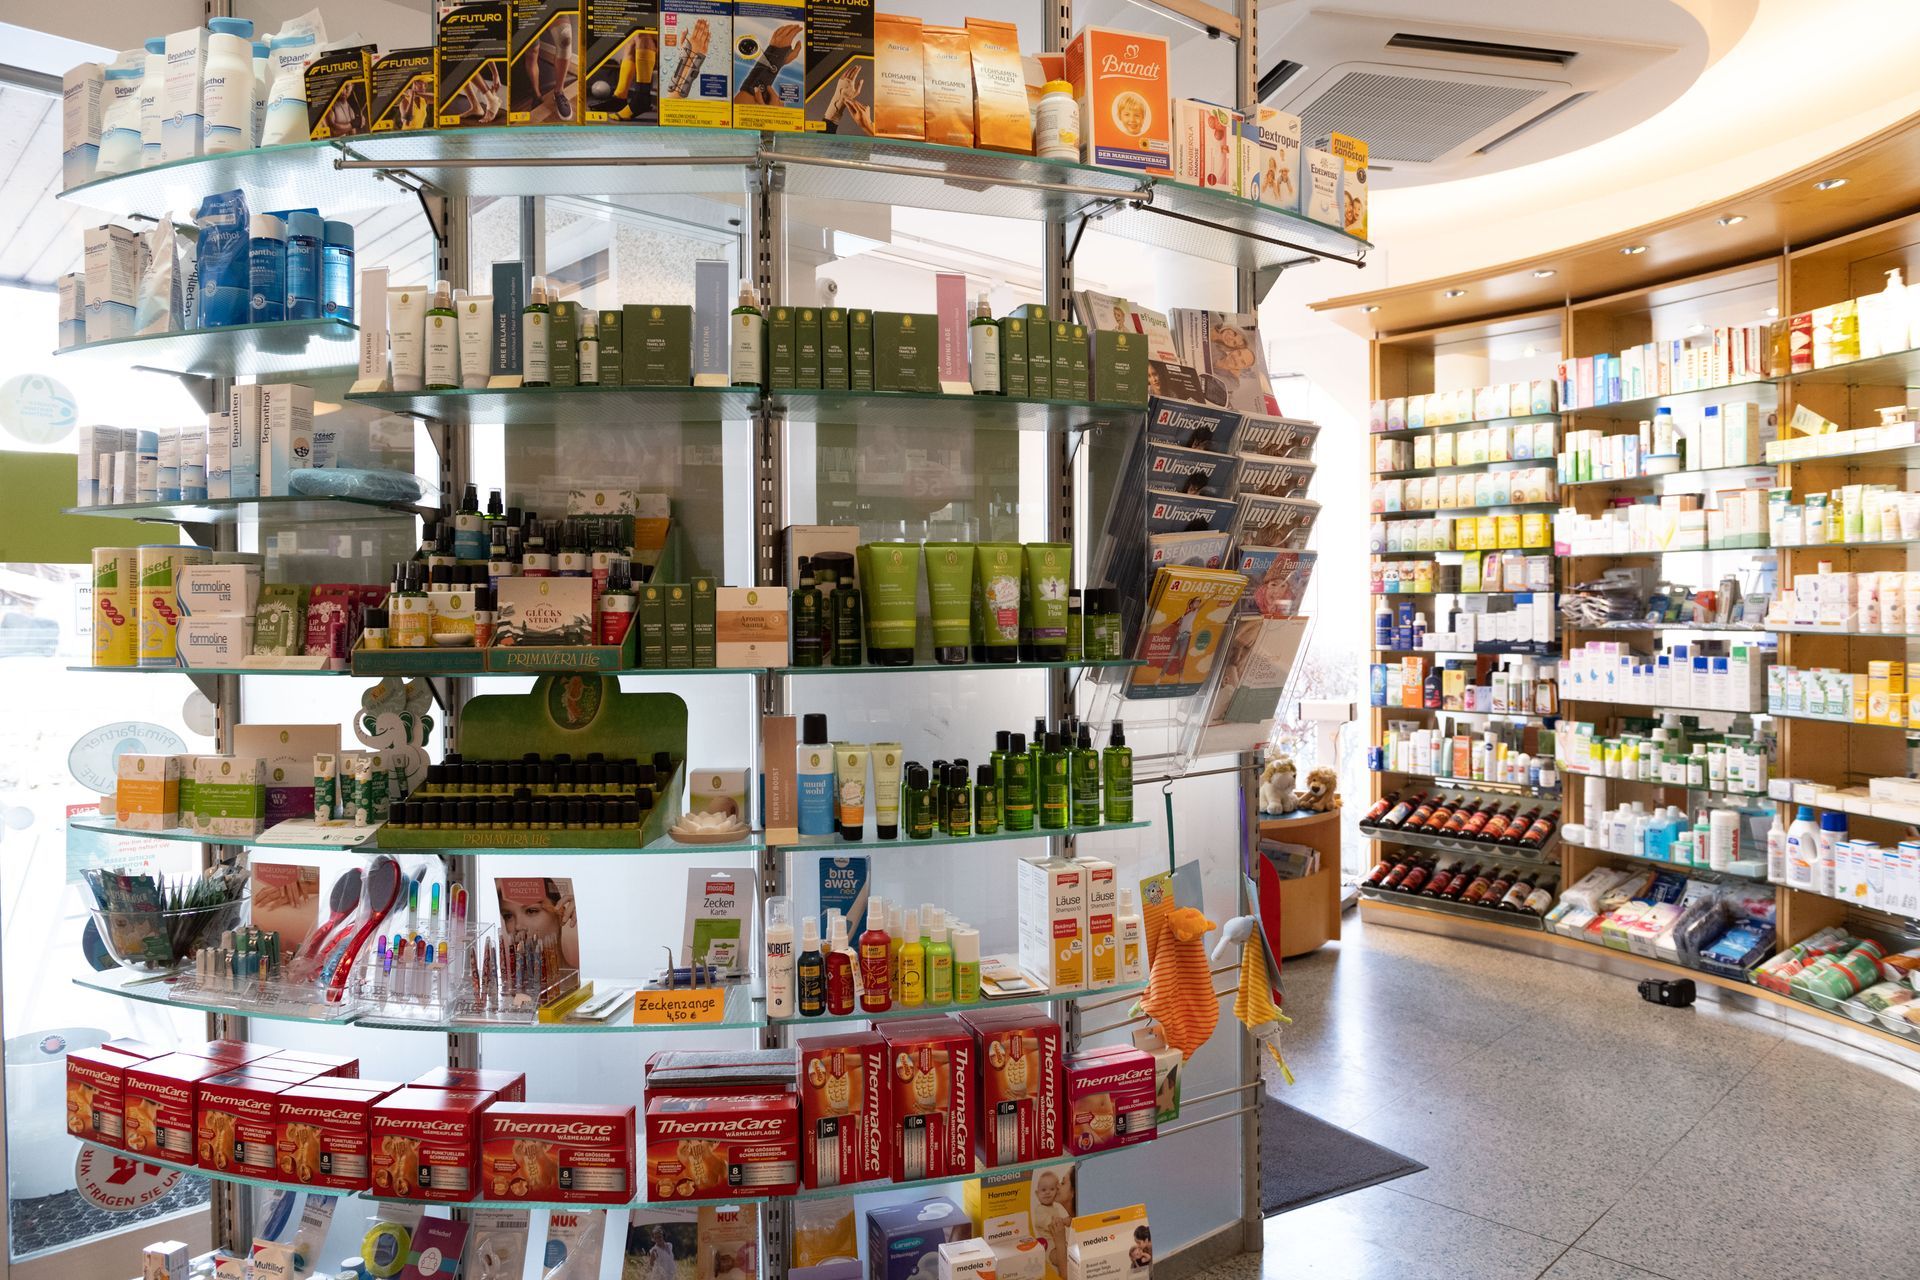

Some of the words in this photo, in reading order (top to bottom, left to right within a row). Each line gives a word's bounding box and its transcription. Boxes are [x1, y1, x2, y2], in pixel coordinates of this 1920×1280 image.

[459, 13, 502, 23] FUTURO
[167, 48, 196, 63] Bepanthol
[320, 61, 358, 73] FUTURO
[389, 57, 429, 69] FUTURO
[1102, 53, 1160, 80] Brandt
[881, 71, 917, 83] FLOHSAMEN
[931, 79, 966, 90] FLOHSAMEN
[720, 119, 730, 127] 3M
[1259, 126, 1299, 150] Dextropur
[1334, 137, 1356, 151] multi-
[1098, 151, 1111, 159] DER
[1334, 147, 1366, 164] sanostol
[1310, 163, 1338, 181] EDELWEISS
[231, 392, 239, 449] Bepanthen
[262, 391, 271, 444] Bepanthol
[1168, 411, 1220, 433] Umschau
[1164, 457, 1216, 478] Umschau
[1165, 503, 1216, 523] Umschau
[1164, 541, 1223, 560] SENIOREN
[1282, 557, 1314, 571] Familie
[191, 580, 231, 595] formoline
[1181, 580, 1242, 597] DIABETES
[525, 608, 562, 617] GLÜCKS
[1047, 602, 1062, 611] Yoga
[740, 615, 765, 623] Aroma
[1047, 609, 1062, 617] Flow
[189, 633, 228, 647] formoline
[1152, 635, 1172, 643] Kleine
[215, 646, 228, 654] L112
[507, 653, 577, 666] PRIMAVERA
[803, 780, 827, 788] mund
[462, 834, 529, 848] PRIMAVERA
[824, 878, 859, 889] away
[509, 887, 540, 895] PINZETTE
[1090, 891, 1115, 902] Läuse
[703, 898, 735, 909] Zecken
[1056, 895, 1081, 906] Läuse
[710, 907, 728, 917] Karte
[1056, 906, 1076, 914] Shampoo
[1091, 917, 1112, 926] Bekämpft
[767, 942, 791, 955] NOBITE
[639, 998, 716, 1013] Zeckenzange
[666, 1010, 687, 1021] 4,50
[67, 1062, 121, 1085] ThermaCare
[1076, 1067, 1153, 1089] ThermaCare
[127, 1077, 190, 1098] ThermaCare
[1041, 1034, 1055, 1152] ThermaCare
[200, 1090, 272, 1111] ThermaCare
[279, 1103, 363, 1121] ThermaCare
[868, 1051, 881, 1172] ThermaCare
[956, 1047, 969, 1167] ThermaCare
[93, 1112, 99, 1121] 12
[1118, 1116, 1124, 1125] 8
[374, 1115, 465, 1132] ThermaCare
[493, 1118, 614, 1135] ThermaCare
[657, 1117, 783, 1134] ThermaCare
[825, 1121, 832, 1133] 16
[157, 1128, 164, 1138] 12
[422, 1129, 463, 1137] WÄRMEAUFLAGEN
[557, 1134, 611, 1142] WÄRMEAUFLAGEN
[725, 1129, 781, 1138] WÄRMEAUFLAGEN
[237, 1143, 242, 1151] 8
[323, 1155, 329, 1163] 8
[431, 1150, 465, 1158] PUNKTUELLEN
[739, 1150, 787, 1158] SCHMERZBEREICHE
[80, 1150, 94, 1177] WIR
[421, 1168, 428, 1176] 8
[562, 1170, 569, 1178] 8
[732, 1167, 739, 1175] 8
[988, 1172, 1021, 1184] medela
[86, 1183, 135, 1207] FRAGEN
[140, 1187, 162, 1202] SIE
[563, 1191, 569, 1199] 2
[988, 1190, 1019, 1200] Harmony
[550, 1215, 578, 1228] NUK
[717, 1212, 739, 1223] NUK
[988, 1230, 1013, 1241] medela
[1083, 1237, 1108, 1247] medela
[255, 1260, 283, 1274] Multilind
[956, 1262, 984, 1273] medela
